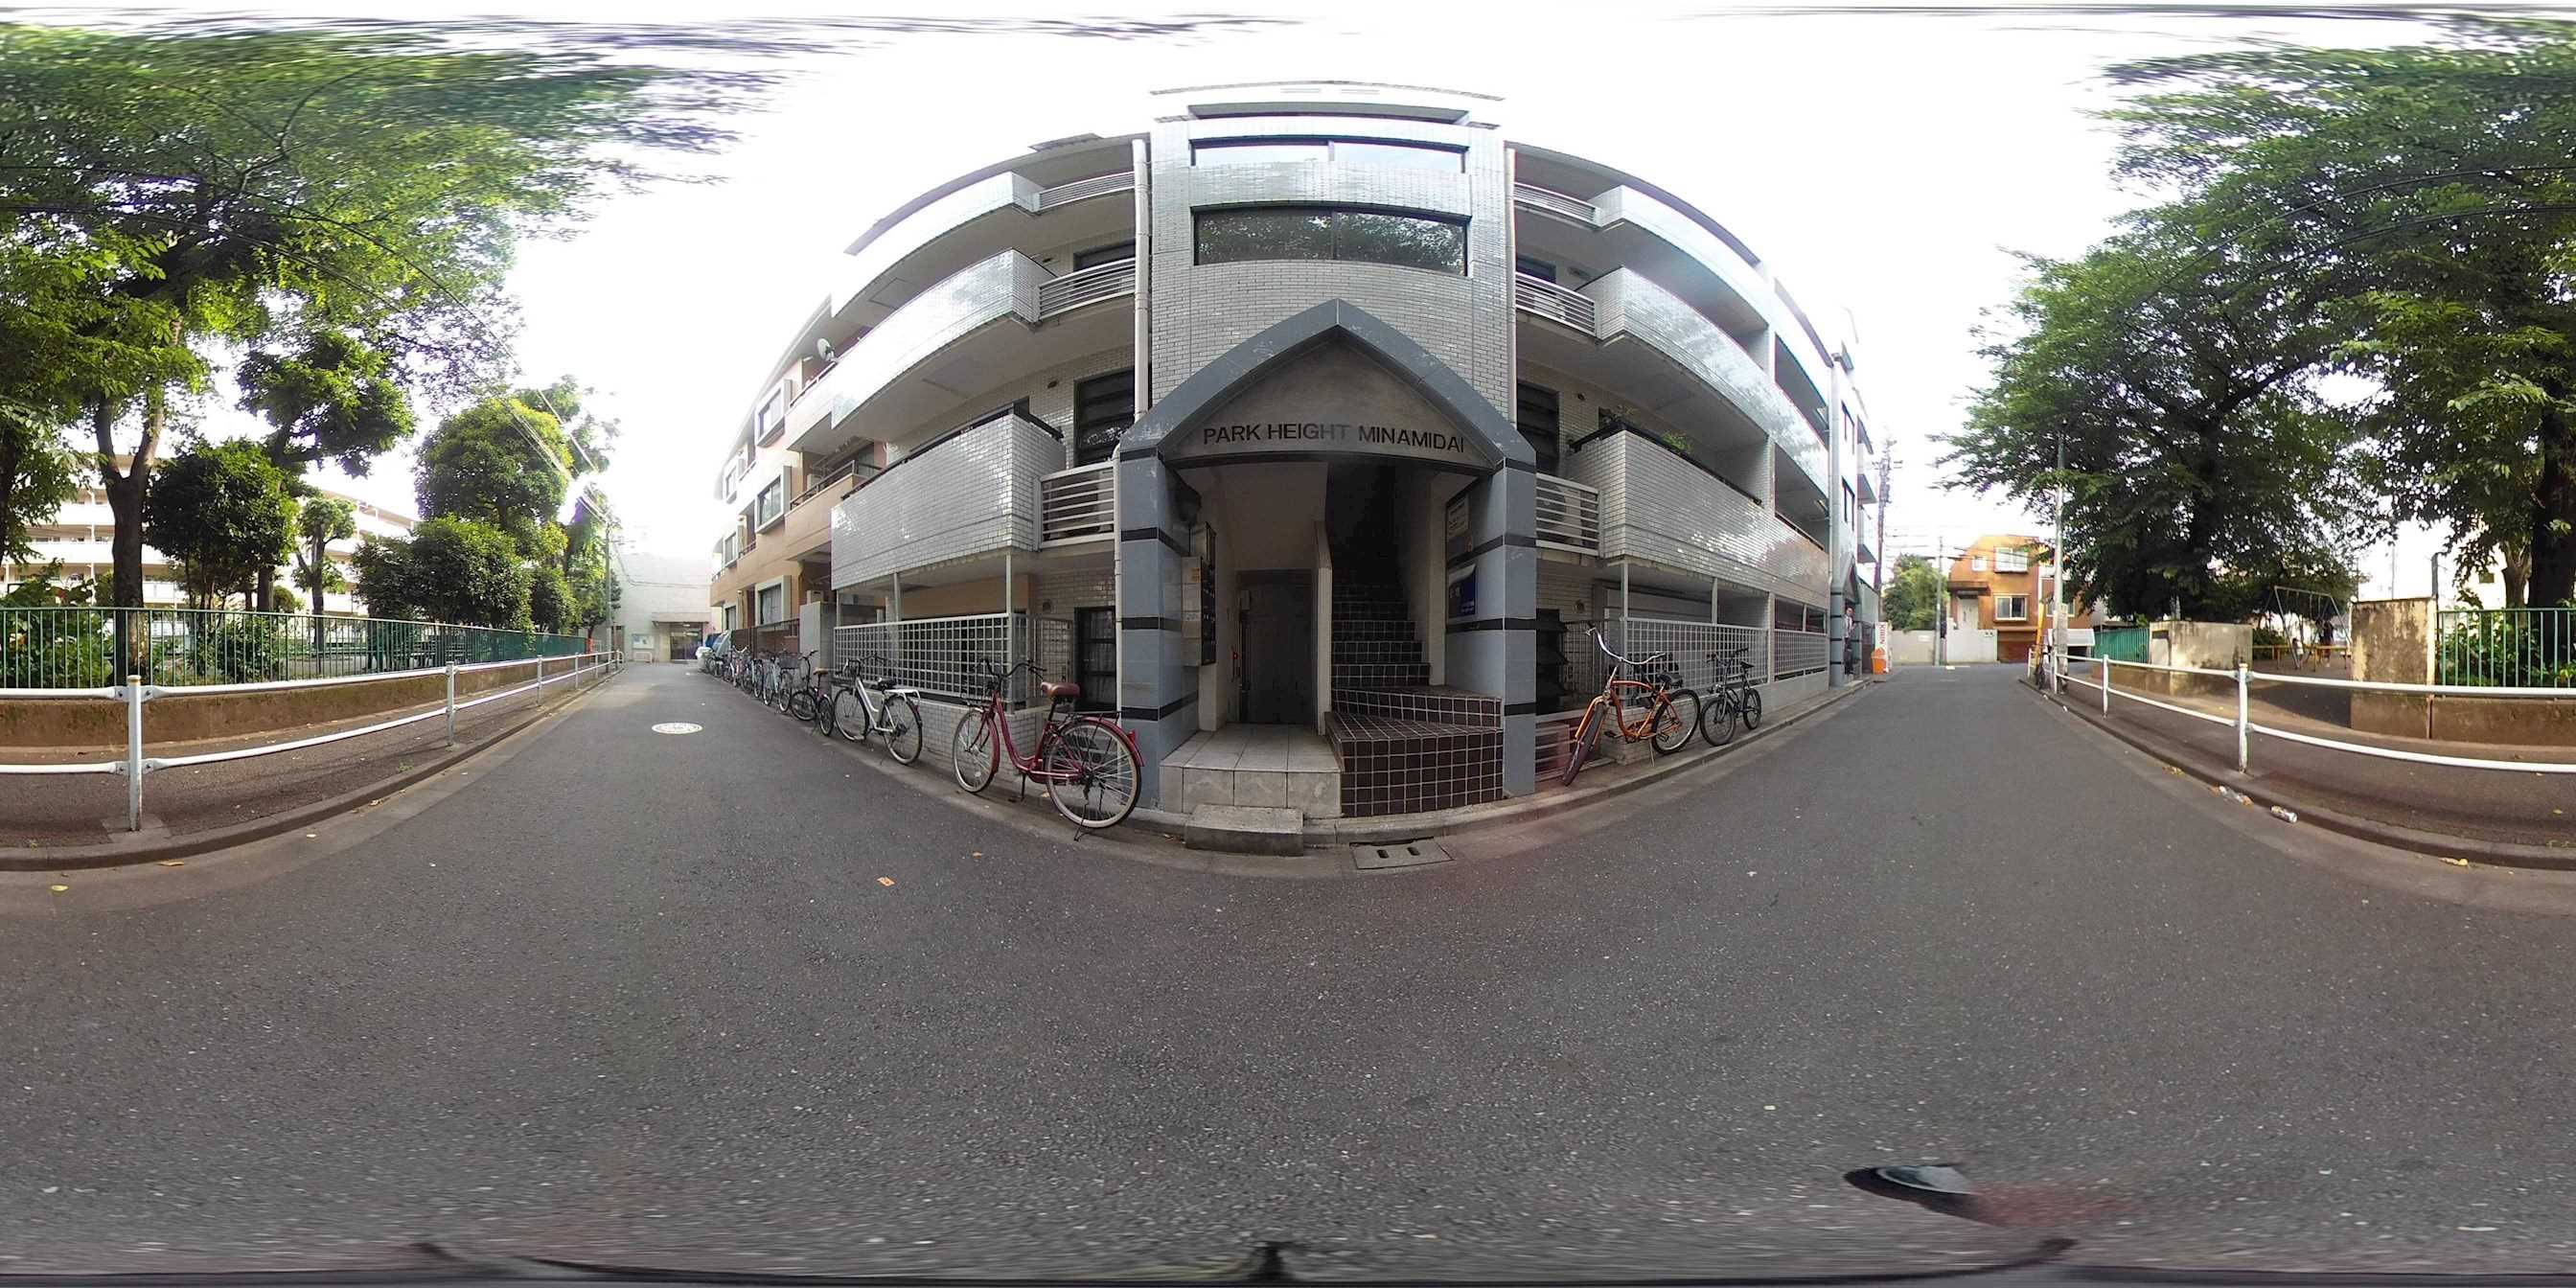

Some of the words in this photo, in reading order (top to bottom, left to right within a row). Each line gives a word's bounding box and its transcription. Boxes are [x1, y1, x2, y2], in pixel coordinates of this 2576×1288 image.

[1204, 424, 1261, 445] PARK
[1268, 423, 1350, 440] HEIGHT
[1359, 426, 1464, 453] MINAMIDAI
